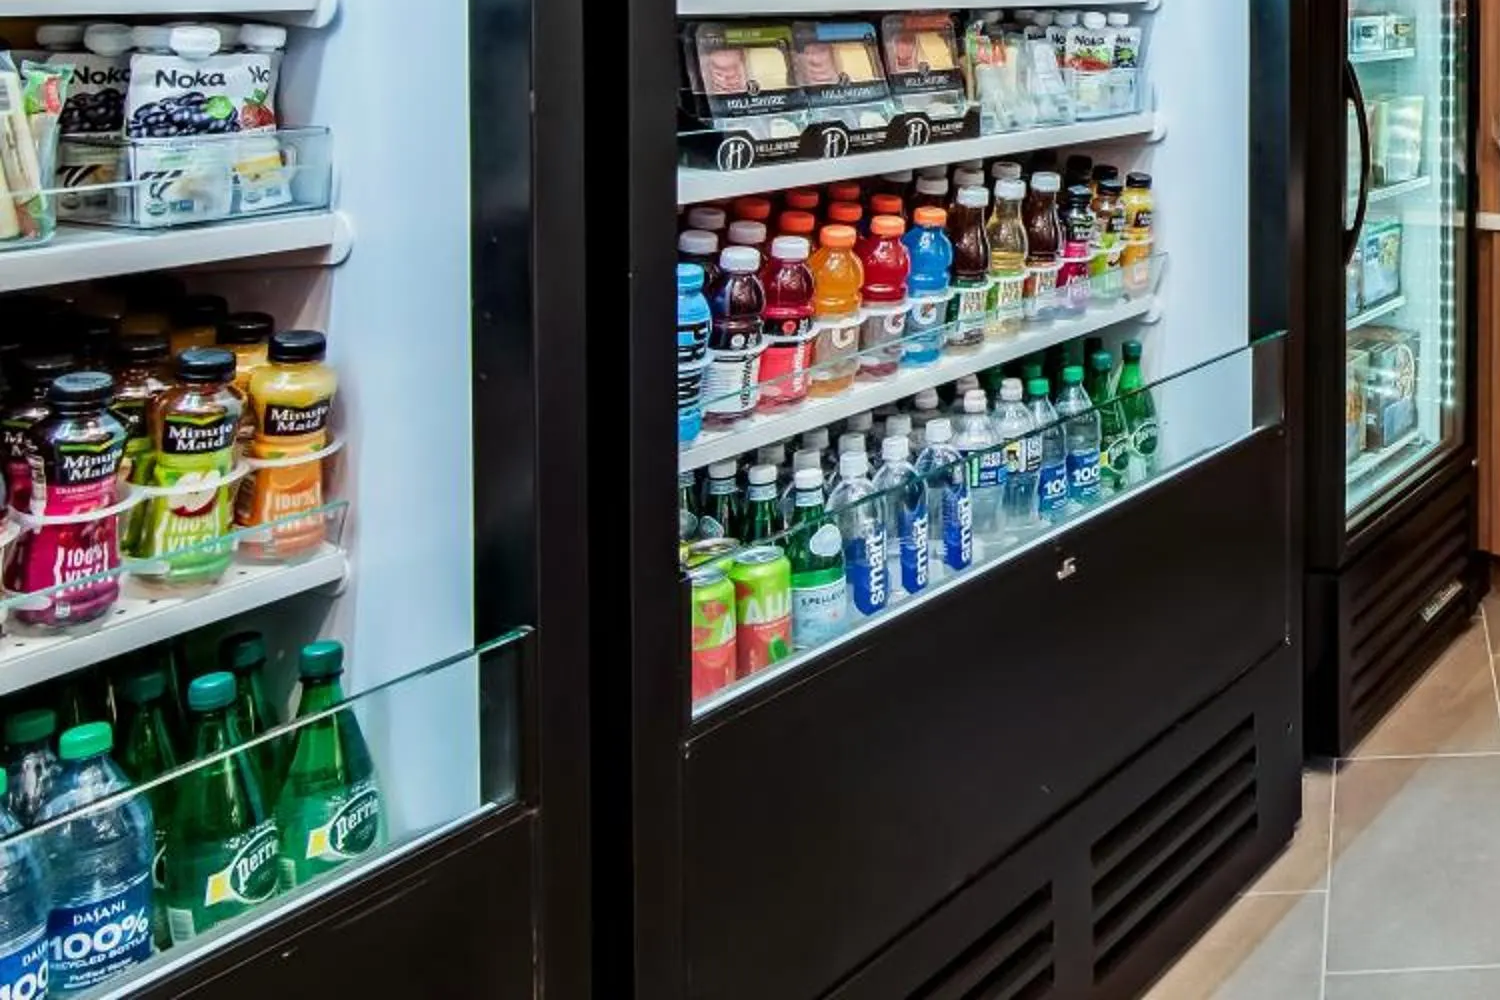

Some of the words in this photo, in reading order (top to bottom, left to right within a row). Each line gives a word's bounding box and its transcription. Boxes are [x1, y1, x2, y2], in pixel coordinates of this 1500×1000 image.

[154, 69, 227, 89] Noka
[168, 422, 233, 440] Minute
[276, 417, 321, 432] Maid
[175, 435, 225, 451] Maid
[69, 461, 116, 482] Maid
[1072, 465, 1100, 482] 100
[865, 530, 884, 606] smart
[73, 899, 127, 927] DASANI
[50, 906, 149, 961] 100%
[0, 958, 49, 1000] 100
